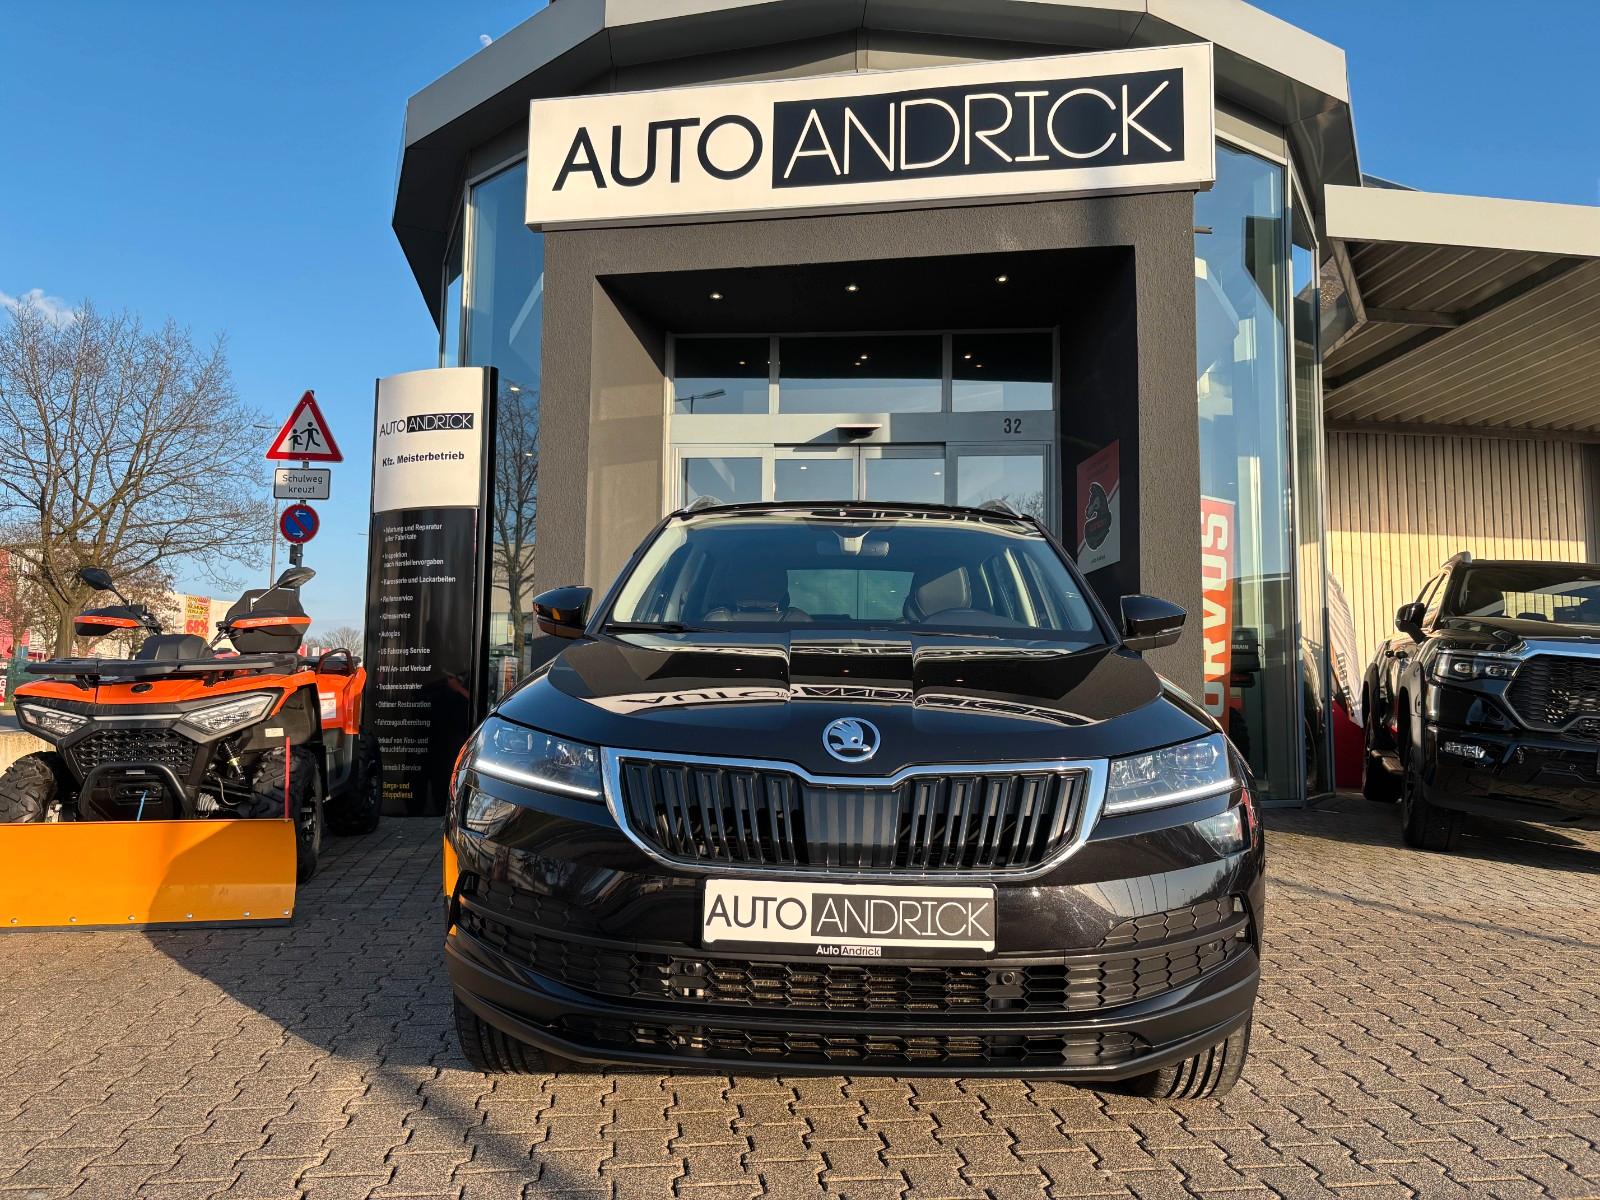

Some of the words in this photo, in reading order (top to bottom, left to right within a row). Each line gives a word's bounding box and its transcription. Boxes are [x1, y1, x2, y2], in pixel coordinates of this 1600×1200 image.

[552, 114, 764, 192] AUTO
[782, 80, 1173, 180] ANDRICK
[379, 419, 406, 437] AUTO
[407, 414, 472, 431] ANDRICK
[1003, 417, 1023, 434] 32
[382, 457, 395, 467] Kfz.
[396, 451, 465, 464] Meisterbetrieb
[282, 474, 323, 485] Schulweg
[288, 486, 315, 494] kreuzt
[415, 523, 443, 531] Reparatur
[419, 575, 456, 583] Lackarbeiten
[409, 646, 431, 654] Service
[399, 664, 410, 672] und
[410, 664, 432, 672] Verkauf
[705, 894, 807, 931] AUTO
[816, 897, 991, 937] ANDRICK
[816, 945, 840, 955] Auto
[841, 945, 881, 956] Andrick
